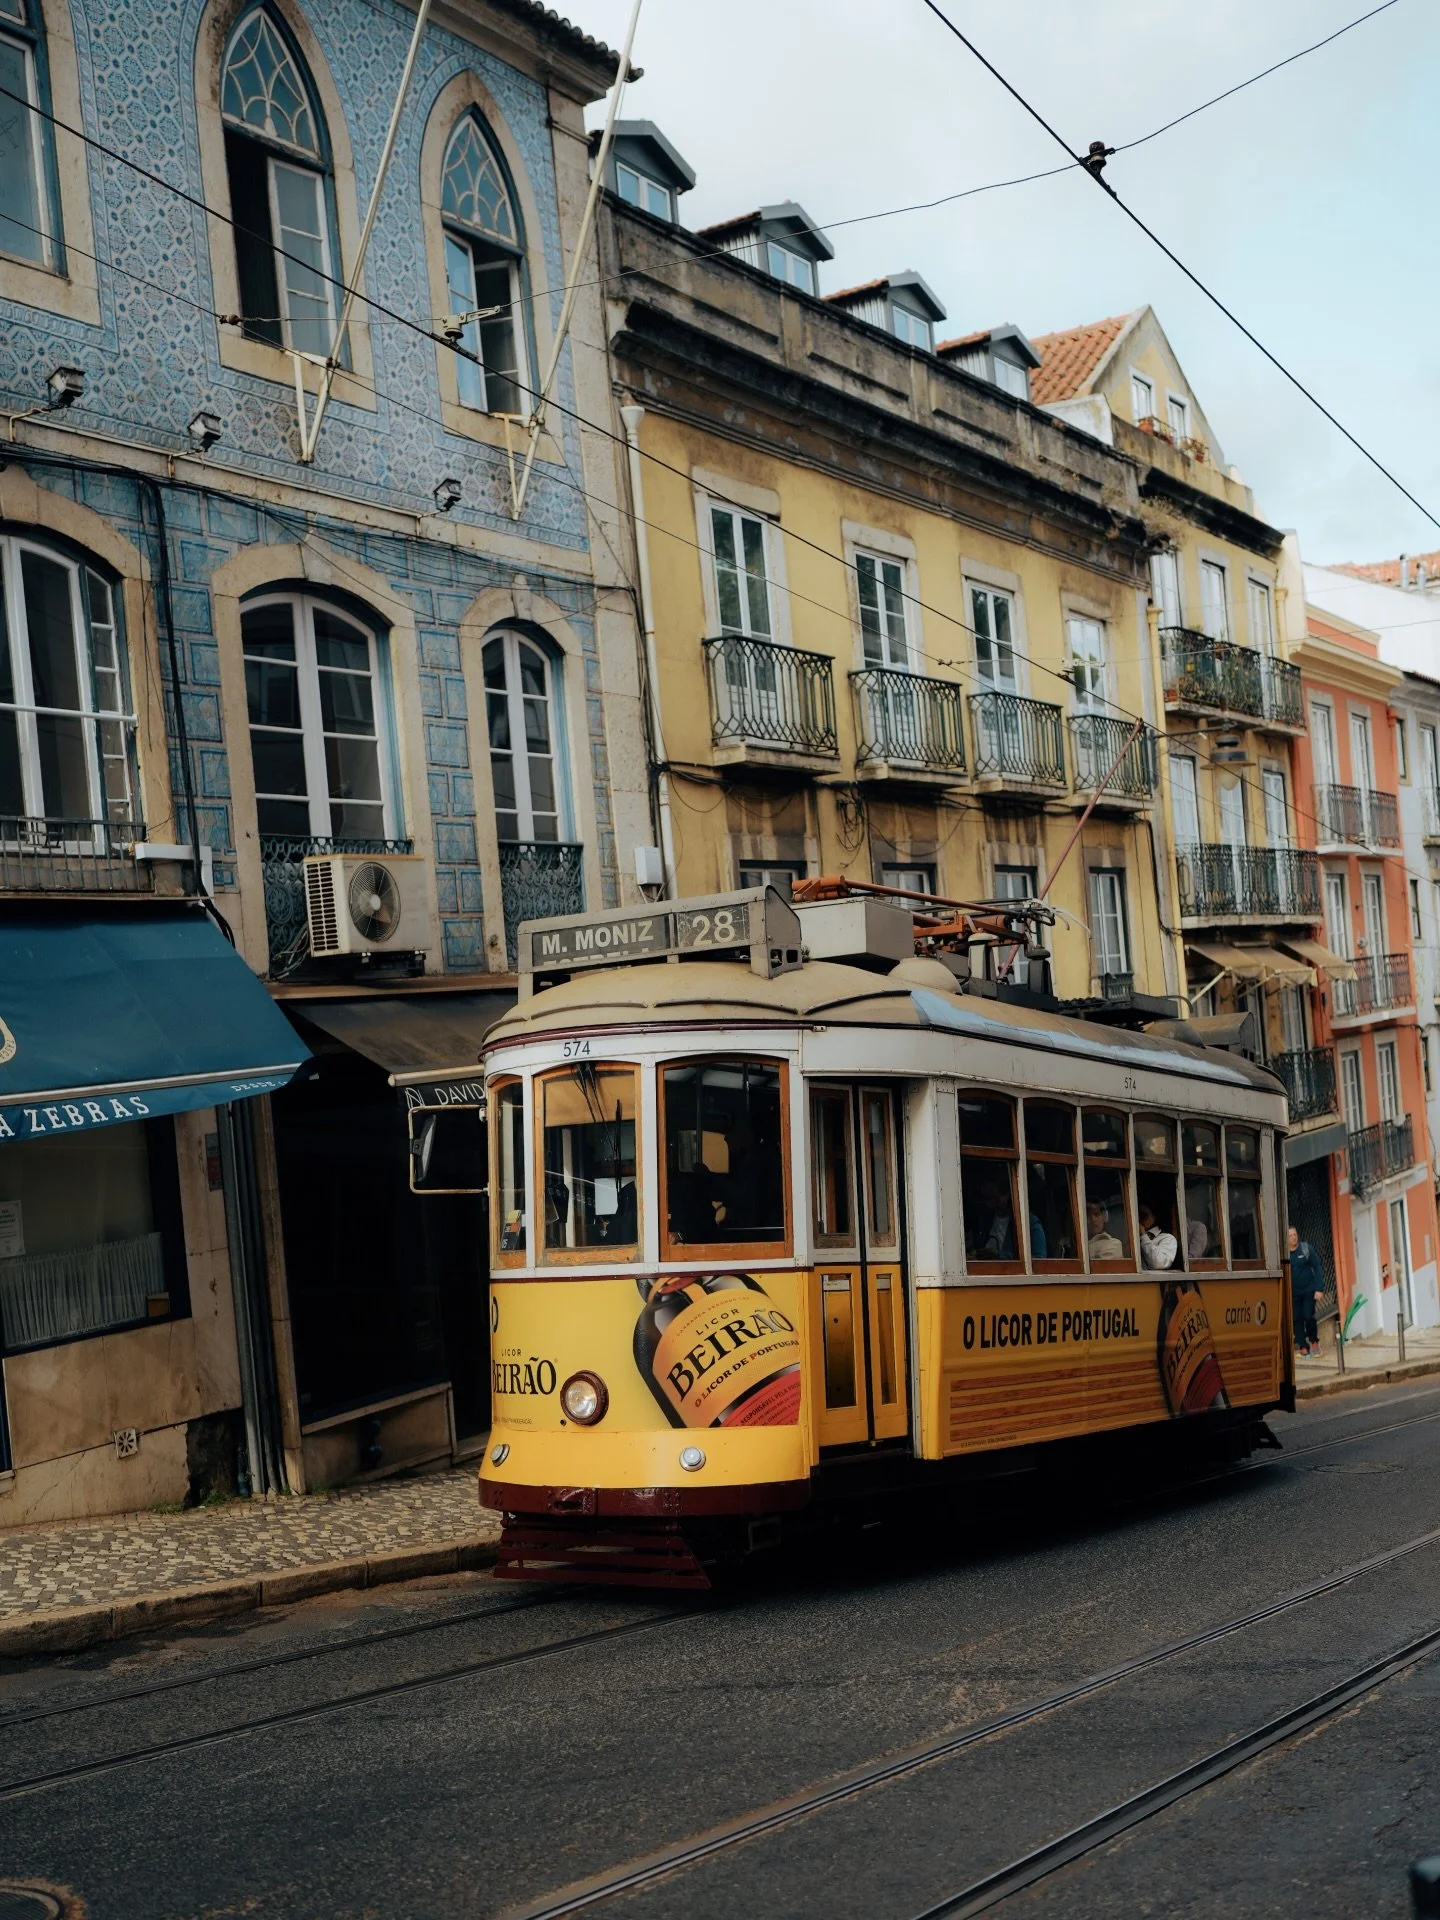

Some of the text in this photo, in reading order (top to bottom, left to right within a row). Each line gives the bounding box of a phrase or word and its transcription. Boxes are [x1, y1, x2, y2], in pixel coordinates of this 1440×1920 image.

[542, 920, 654, 955] M. MONIZ
[692, 911, 735, 946] 28
[563, 1041, 591, 1057] 574
[434, 1083, 486, 1105] DAVID
[1124, 1077, 1136, 1090] 574
[23, 1096, 150, 1132] ZEBRAS
[696, 1308, 740, 1335] LICOR
[1225, 1300, 1251, 1324] carris
[963, 1308, 1140, 1350] O LICOR DE PORTUGAL
[501, 1349, 522, 1357] LICOR
[666, 1308, 794, 1402] BEIRÃO
[694, 1398, 702, 1408] O
[701, 1370, 732, 1400] LICOR
[732, 1357, 749, 1371] DE
